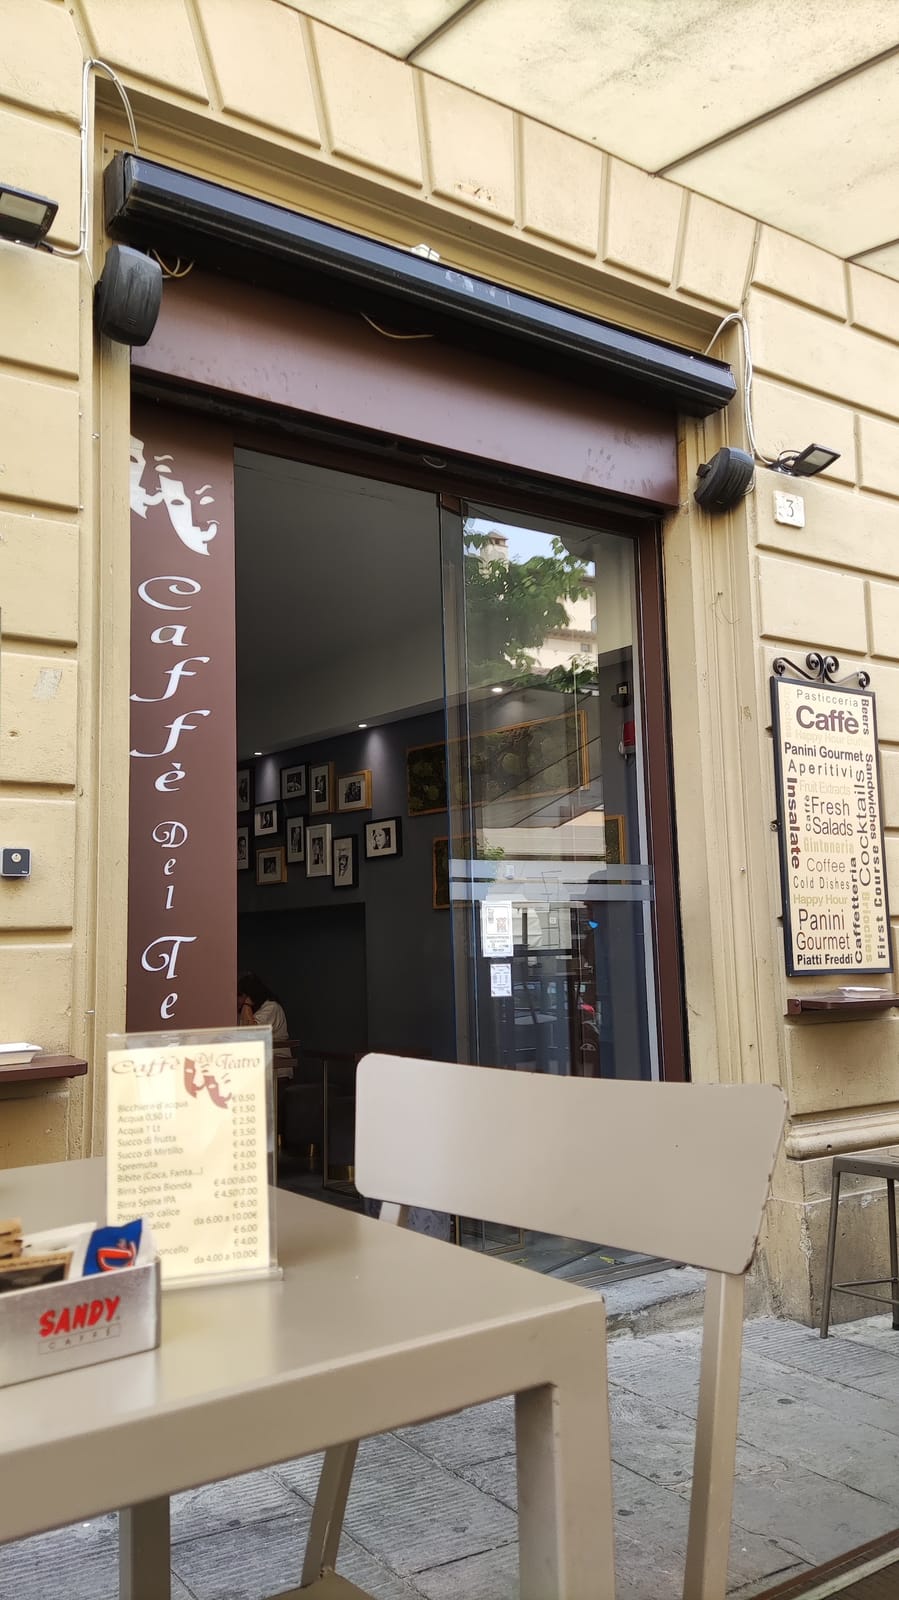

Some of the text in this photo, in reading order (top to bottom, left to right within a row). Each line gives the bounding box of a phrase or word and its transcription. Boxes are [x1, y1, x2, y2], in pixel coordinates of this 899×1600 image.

[786, 499, 794, 517] 3
[129, 576, 211, 792] Caffè
[796, 689, 859, 708] Pasticceria
[796, 705, 859, 735] Caffè
[861, 699, 870, 736] Beers
[784, 742, 864, 762] Panini Gourmet
[788, 758, 853, 778] Aperitivi
[865, 753, 877, 840] Sandwiches
[811, 796, 850, 816] Fresh
[787, 777, 800, 869] Insalate
[812, 816, 854, 836] Salads
[854, 770, 871, 887] Cocktails
[803, 837, 855, 854] Gintoneria
[152, 821, 188, 909] Del
[806, 858, 846, 872] Coffee
[793, 875, 850, 890] Cold Dishes
[793, 894, 848, 907] Happy Hour
[872, 845, 886, 959] First Course
[850, 857, 863, 964] Caffetteria
[798, 908, 845, 931] Panini
[796, 931, 850, 950] Gourmet
[797, 953, 853, 965] Piatti Freddi
[215, 1053, 261, 1070] Teatro
[238, 1093, 256, 1102] 0.50
[239, 1105, 256, 1113] 1.50
[118, 1115, 144, 1123] Acqua
[239, 1117, 256, 1125] 2.50
[118, 1127, 144, 1136] Acqua
[239, 1128, 256, 1137] 3.50
[117, 1139, 143, 1147] Succo
[154, 1135, 177, 1144] frutta
[240, 1139, 256, 1148] 4.00
[117, 1151, 143, 1160] Succo
[240, 1151, 256, 1159] 4.00
[117, 1161, 158, 1172] Spremuta
[240, 1162, 257, 1170] 3.50
[117, 1174, 141, 1183] Bibite
[117, 1182, 192, 1196] Birra Spina Bionda
[117, 1196, 177, 1209] Birra Spina IPA
[157, 1208, 181, 1217] calice
[194, 1217, 205, 1226] da
[206, 1215, 223, 1225] 6.00
[194, 1255, 205, 1264] da
[206, 1253, 223, 1262] 4.00
[38, 1295, 121, 1338] SANDY
